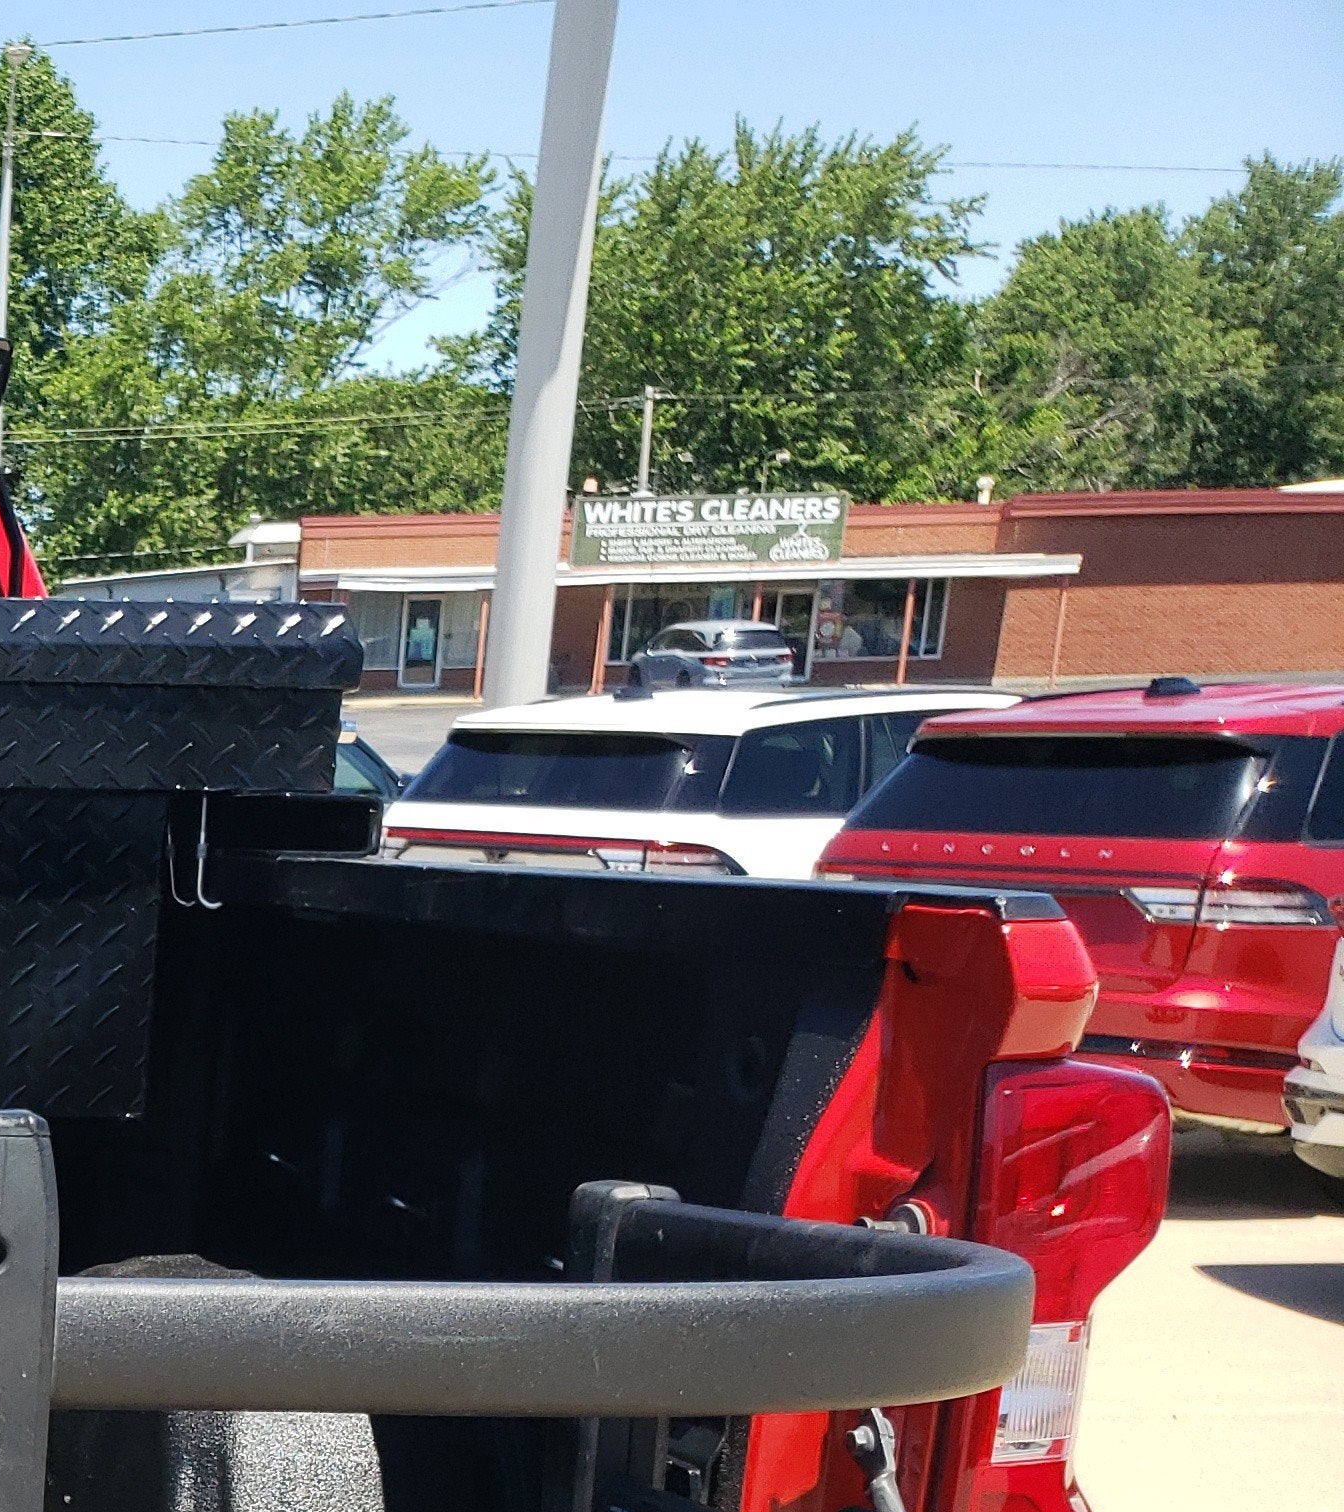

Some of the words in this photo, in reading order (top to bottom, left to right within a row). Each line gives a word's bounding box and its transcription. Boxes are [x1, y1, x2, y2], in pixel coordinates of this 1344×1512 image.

[583, 500, 694, 524] WHITE'S
[700, 496, 841, 521] CLEANERS
[585, 525, 681, 538] PROFESSIONAL
[880, 841, 1113, 859] LINCOLN
